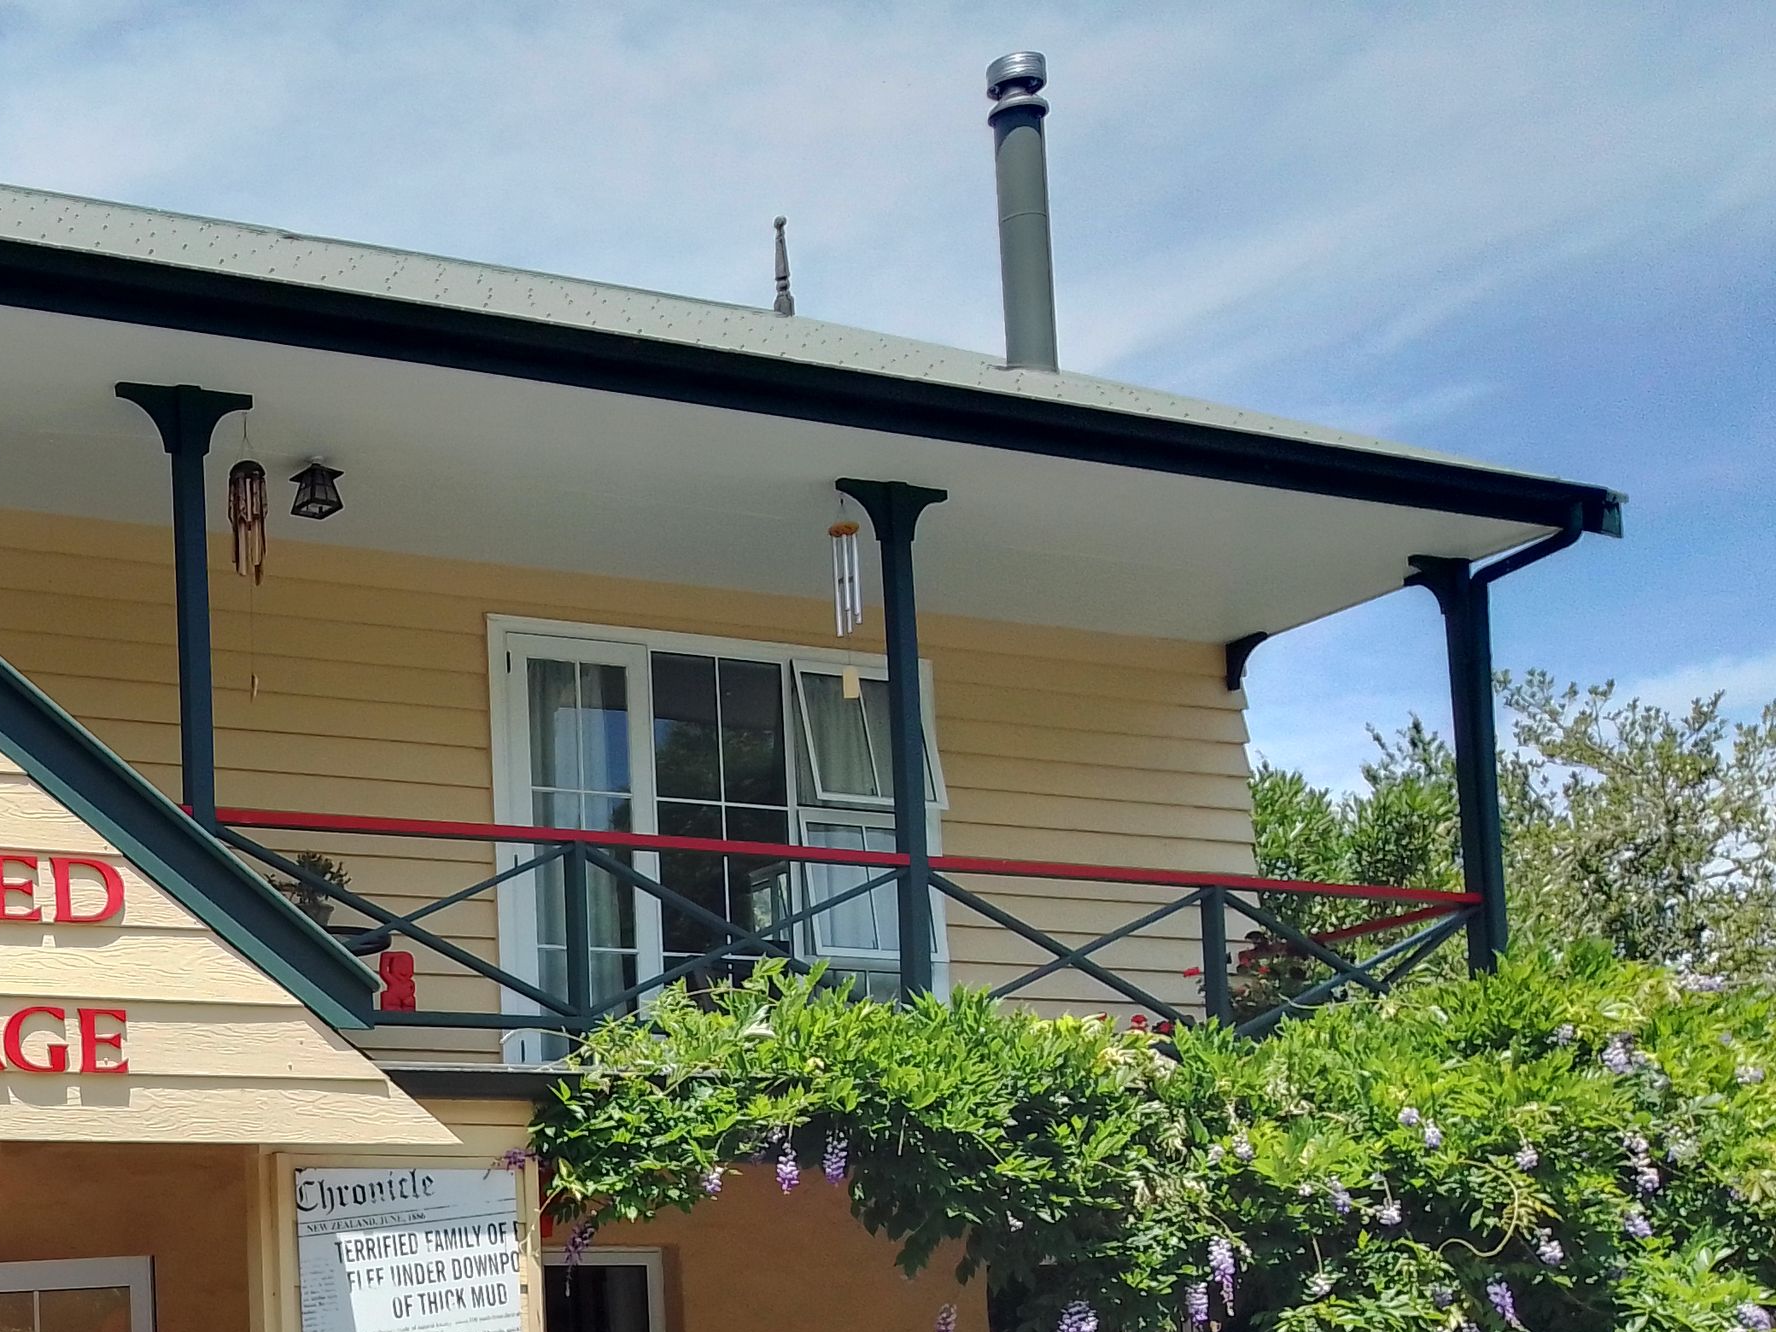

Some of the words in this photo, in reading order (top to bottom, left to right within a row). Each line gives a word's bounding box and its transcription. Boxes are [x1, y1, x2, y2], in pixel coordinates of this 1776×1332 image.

[296, 1168, 435, 1216] Chronicle
[334, 1232, 419, 1264] TERRIFIED
[425, 1223, 482, 1253] FAMILY
[487, 1221, 508, 1246] OF
[390, 1258, 447, 1288] UNDER
[392, 1294, 414, 1320] OF
[418, 1286, 467, 1316] THICK
[471, 1282, 509, 1309] MUD
